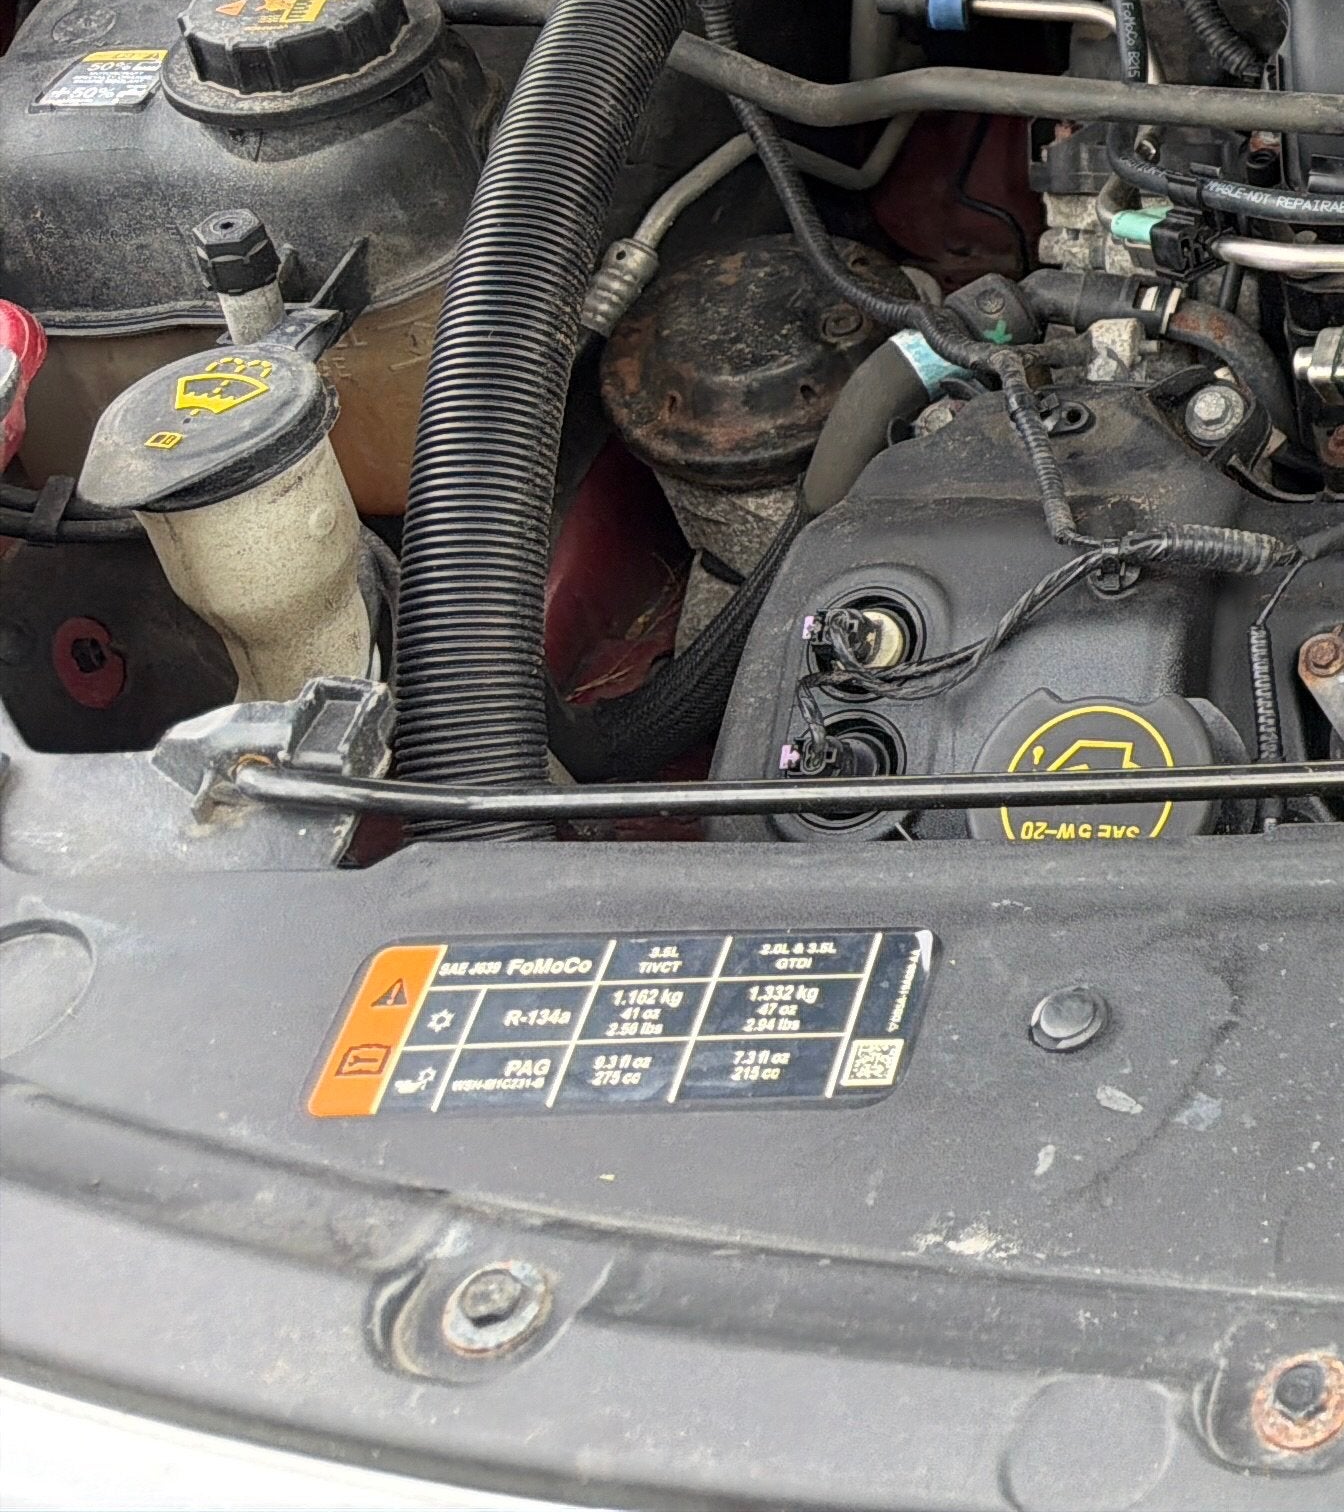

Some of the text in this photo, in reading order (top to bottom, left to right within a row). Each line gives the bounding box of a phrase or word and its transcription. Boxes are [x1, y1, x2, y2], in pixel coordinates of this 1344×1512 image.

[1121, 1, 1138, 46] FoMoCo
[1020, 821, 1140, 839] SAE 5W-20
[439, 961, 469, 976] SAE
[507, 956, 593, 976] FoMoCo
[638, 960, 683, 974] TIVCT
[612, 988, 684, 1008] 1.162 kg
[749, 984, 819, 1004] 1.332 kg
[504, 1008, 571, 1027] R-134a
[620, 1007, 662, 1020] 41 oz
[756, 1002, 798, 1016] 47 oz
[640, 1022, 664, 1035] lbs
[777, 1017, 800, 1031] lbs
[503, 1058, 551, 1077] PAG
[771, 1052, 791, 1065] oz
